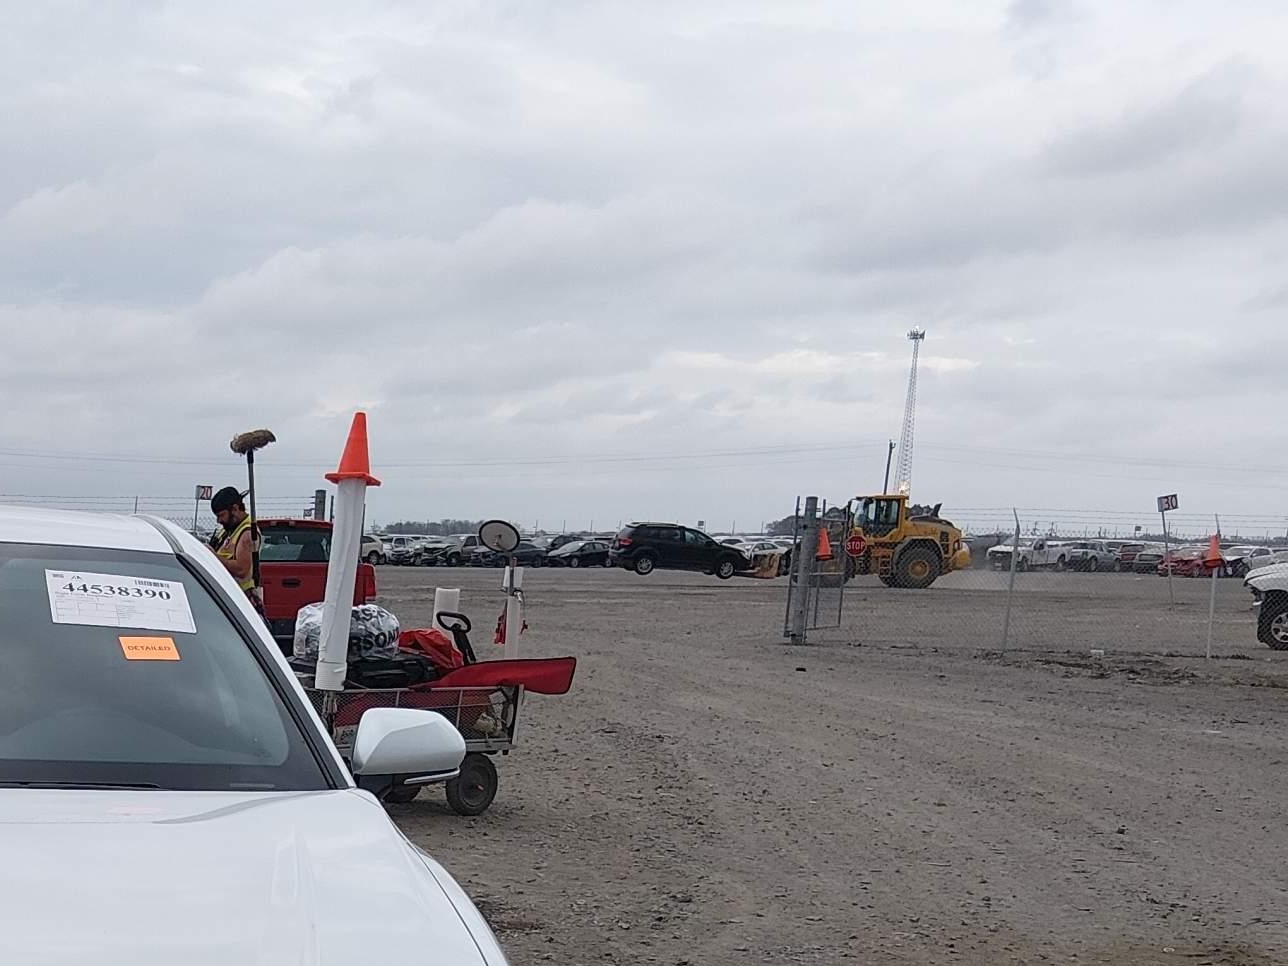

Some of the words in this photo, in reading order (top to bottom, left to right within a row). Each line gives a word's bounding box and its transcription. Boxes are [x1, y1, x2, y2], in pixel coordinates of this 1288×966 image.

[199, 486, 213, 500] 20
[1164, 494, 1179, 511] 30
[846, 541, 866, 551] STOP
[62, 582, 171, 601] 44538390
